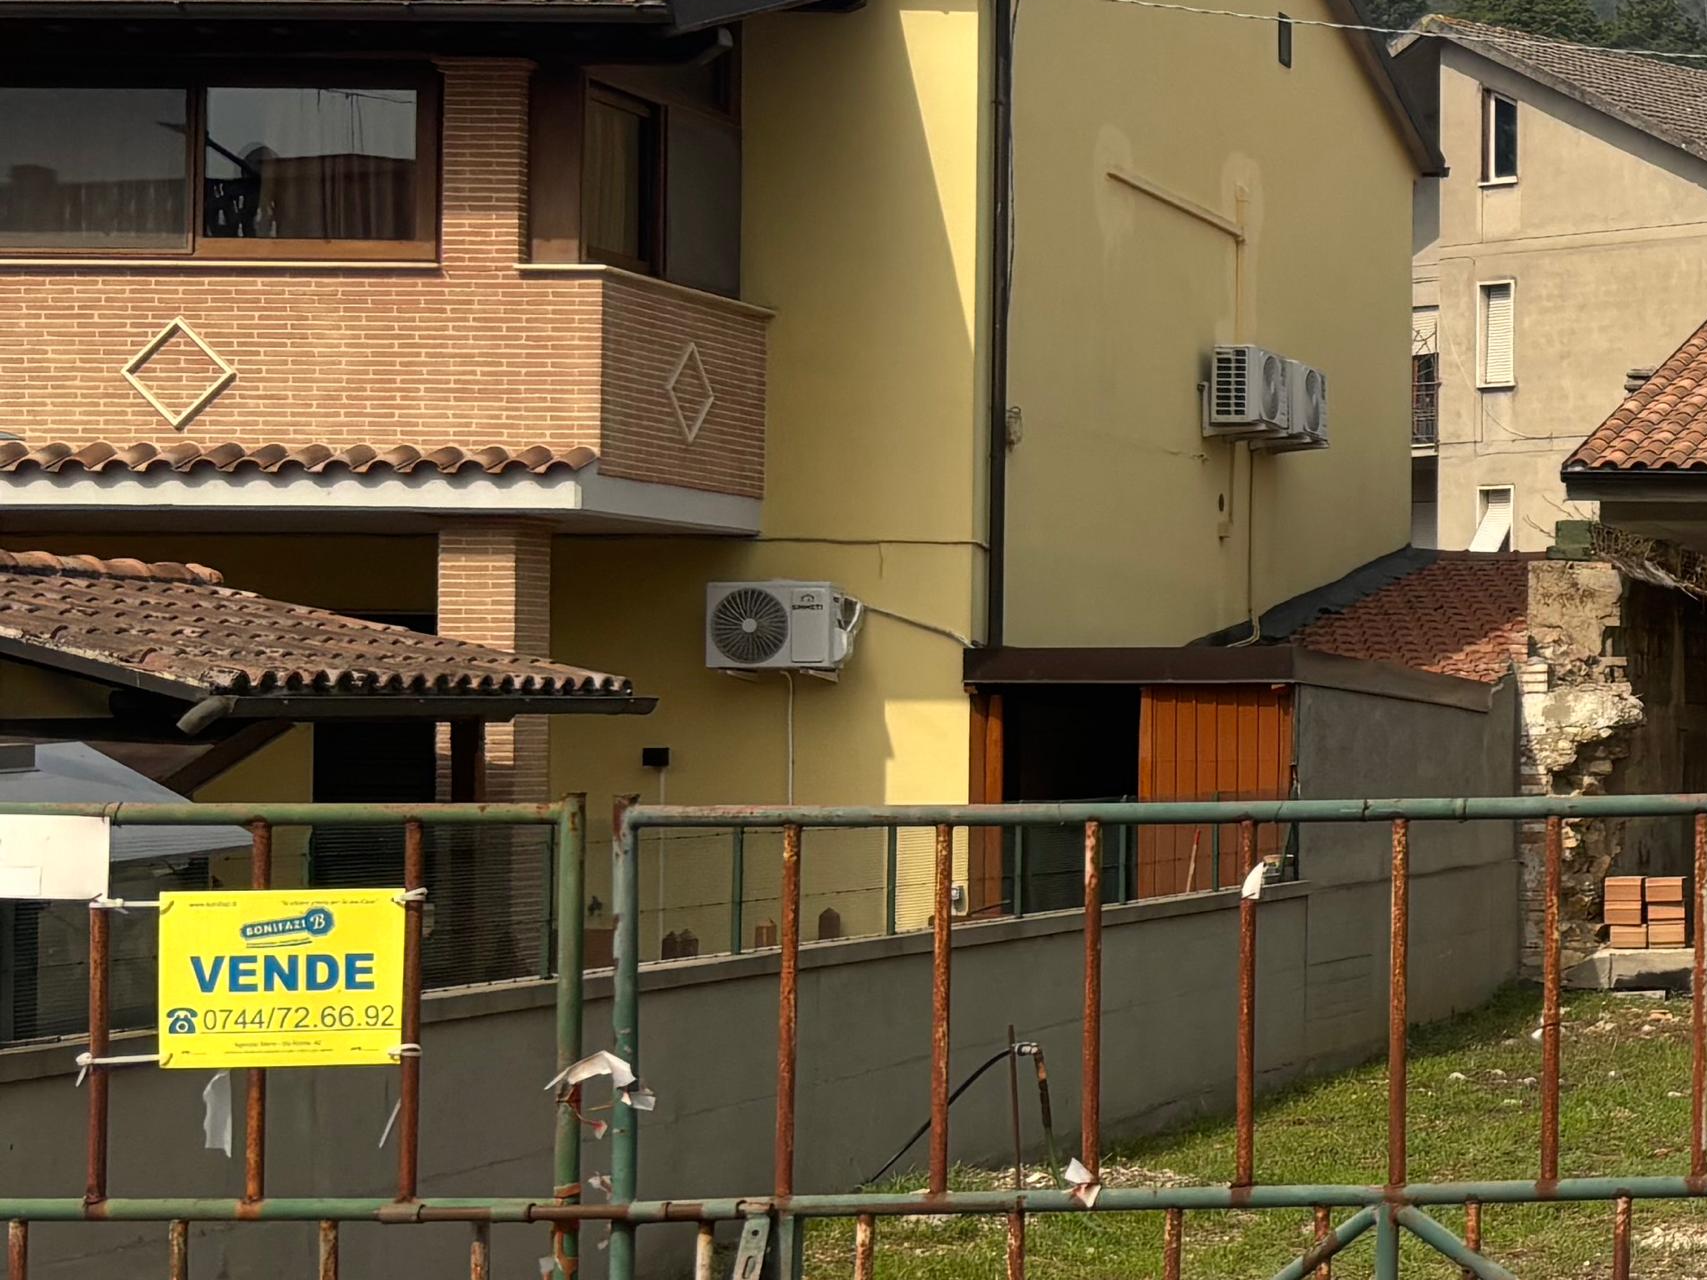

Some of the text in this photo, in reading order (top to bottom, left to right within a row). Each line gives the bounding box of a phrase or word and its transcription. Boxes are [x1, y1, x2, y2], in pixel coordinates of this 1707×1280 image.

[245, 913, 326, 937] BONIFAZI B
[190, 953, 376, 993] VENDE
[203, 1005, 395, 1030] 0744/72.66.92
